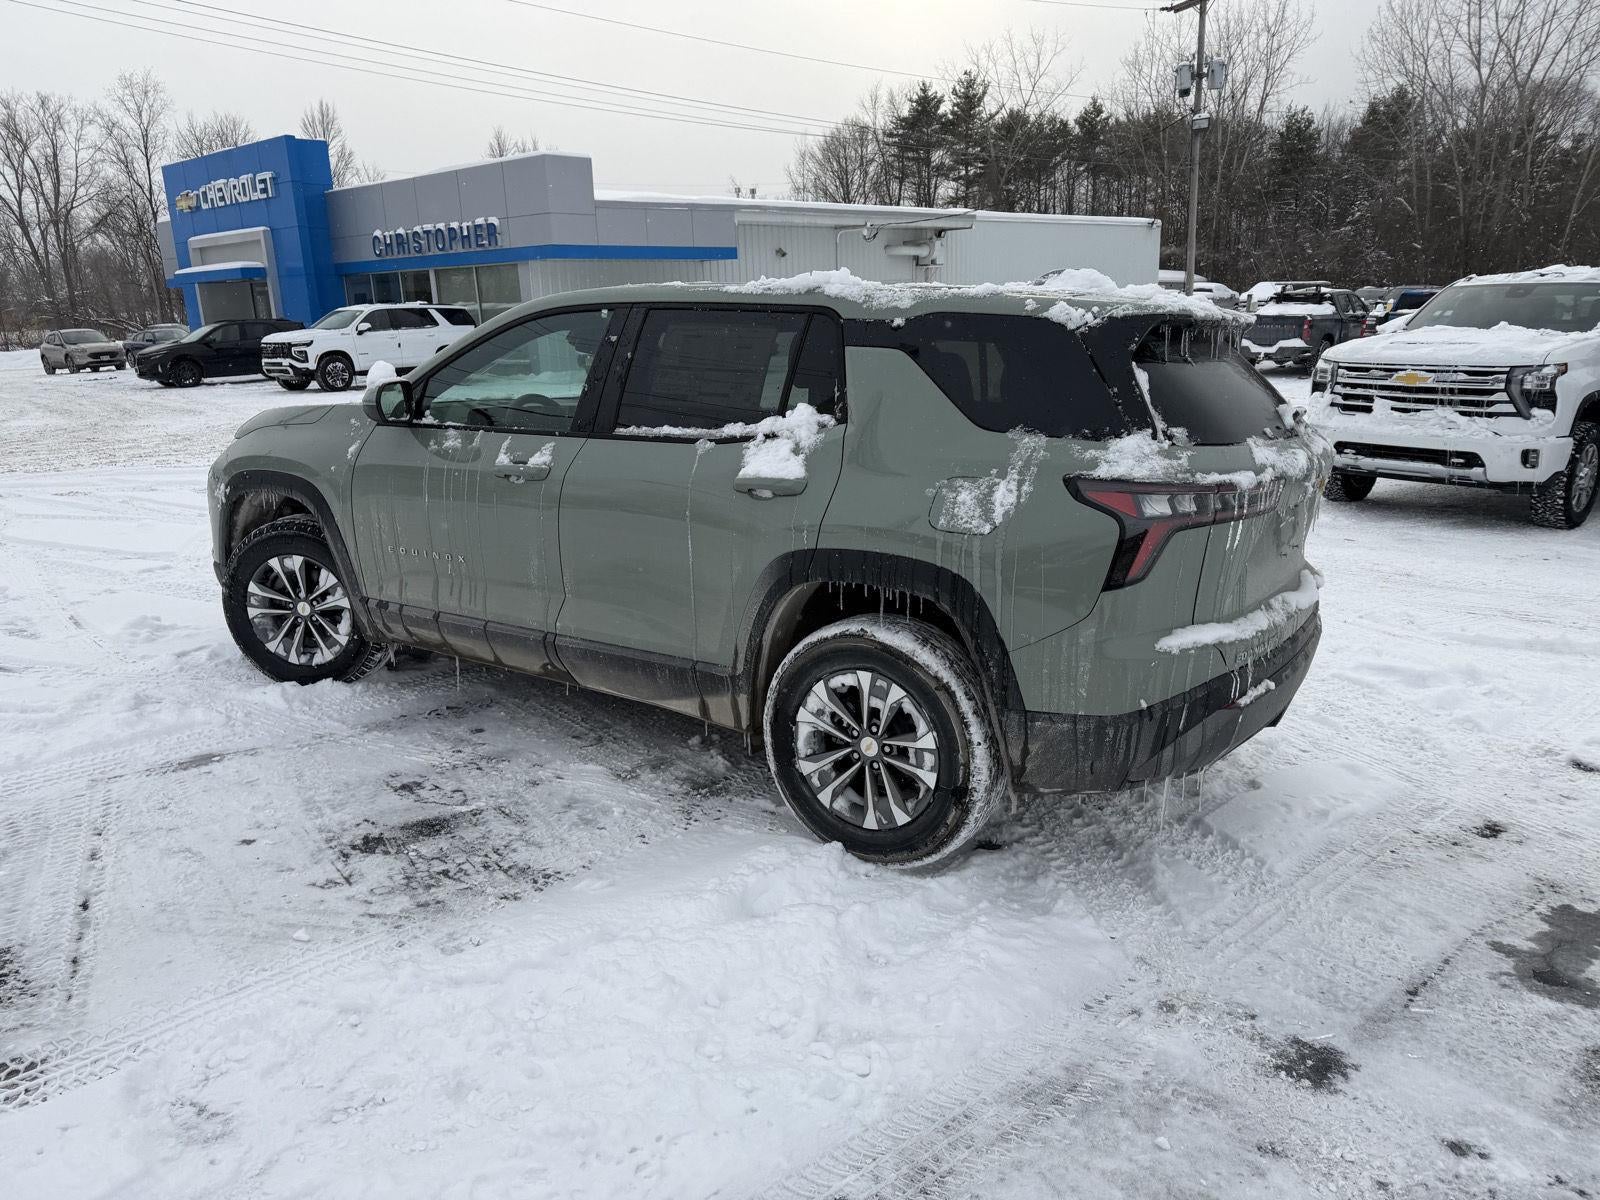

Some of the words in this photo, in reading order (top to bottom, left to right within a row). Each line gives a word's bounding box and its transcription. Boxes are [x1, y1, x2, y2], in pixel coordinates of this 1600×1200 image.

[199, 171, 274, 210] CHEVROLET
[372, 217, 499, 257] CHRISTOPHER
[387, 544, 465, 563] EQUINOX
